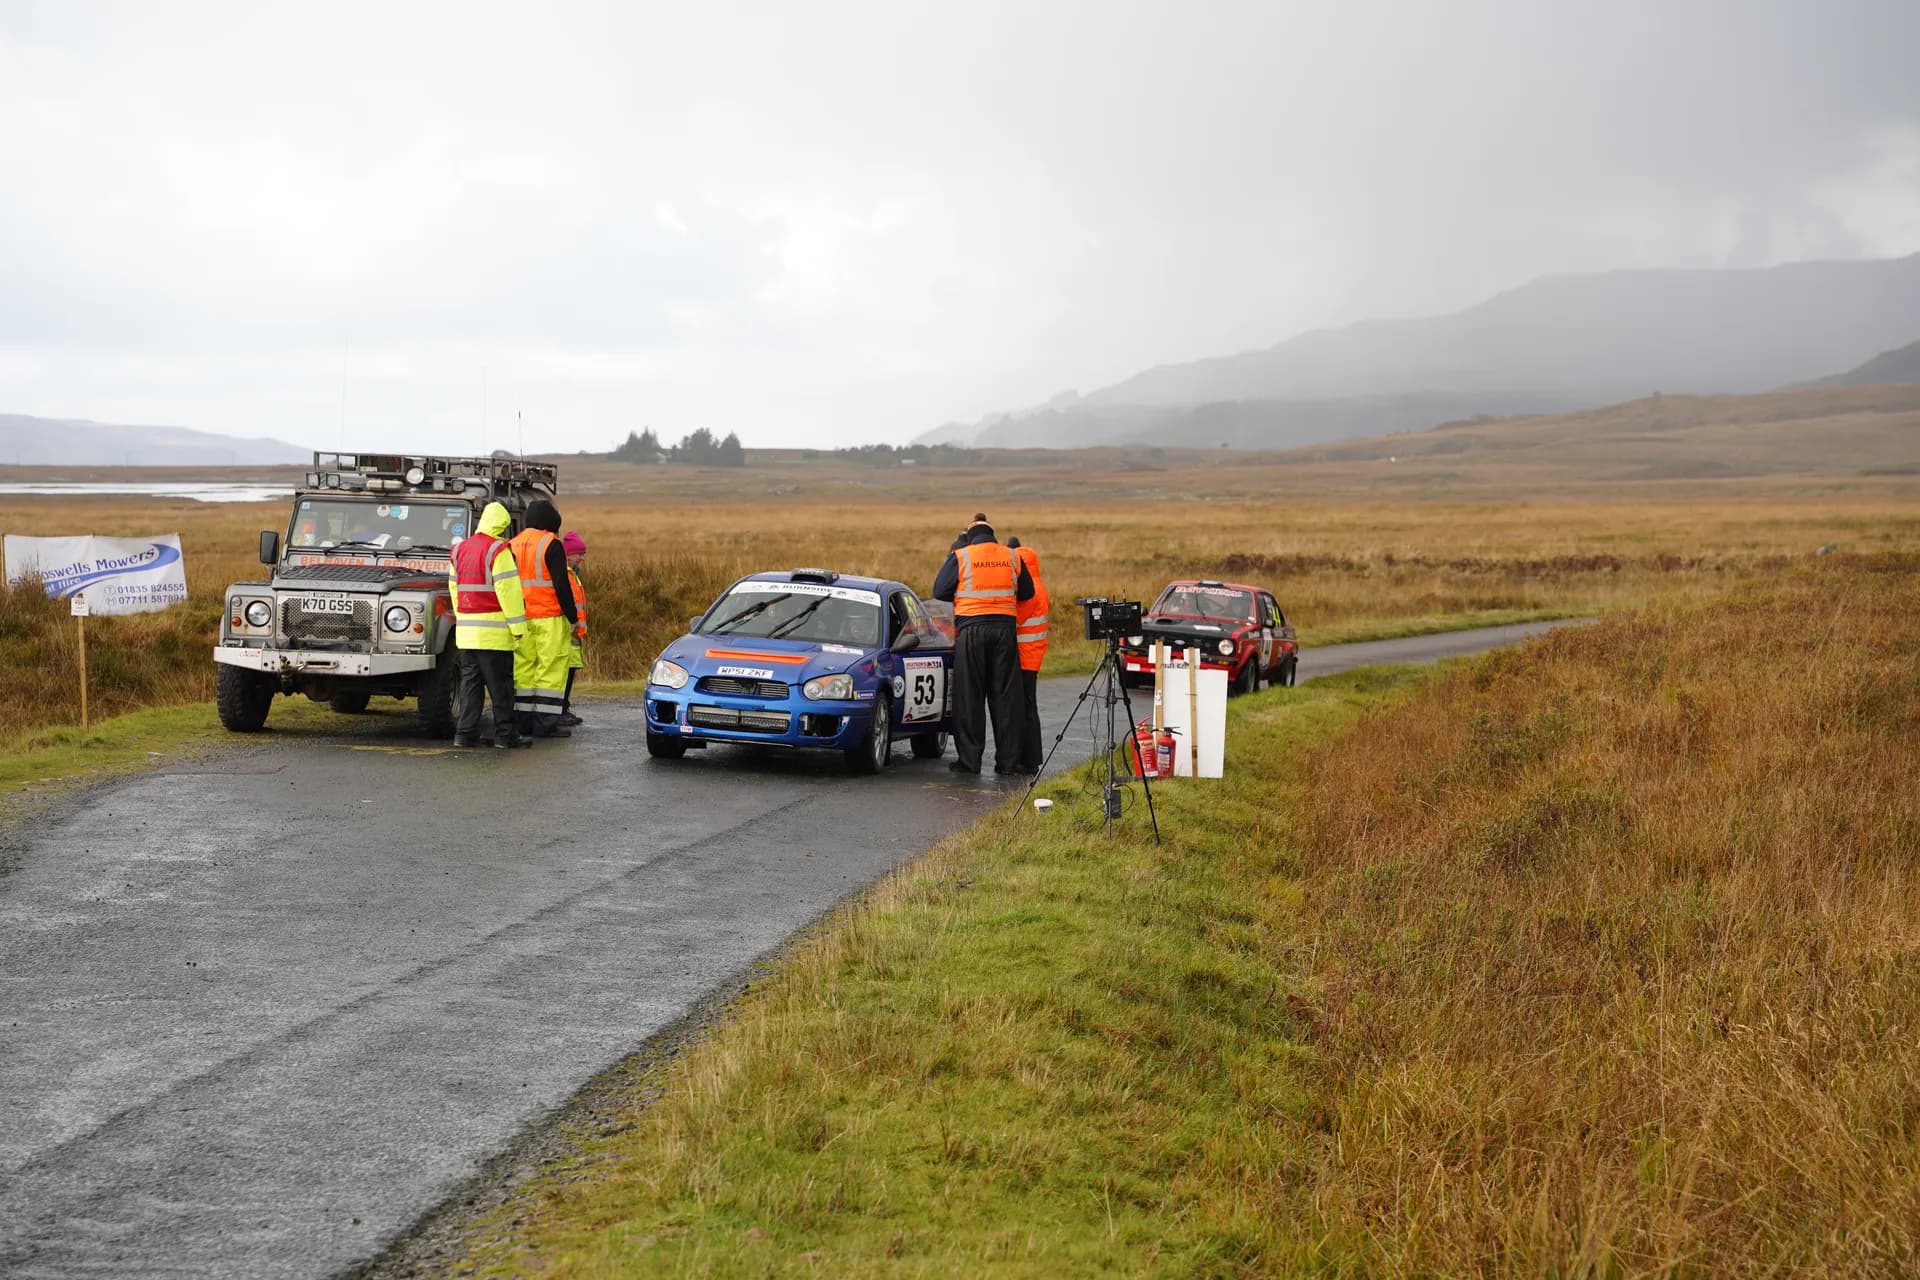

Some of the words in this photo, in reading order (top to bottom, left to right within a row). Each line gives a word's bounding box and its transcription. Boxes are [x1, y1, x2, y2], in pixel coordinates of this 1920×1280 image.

[96, 548, 155, 570] Mowers
[384, 559, 449, 570] RECOVERY
[973, 560, 1011, 569] MARSHAL
[150, 583, 185, 593] 824555
[118, 595, 148, 604] 07711
[302, 598, 326, 610] K70
[329, 599, 353, 612] GSS
[913, 674, 936, 706] 53
